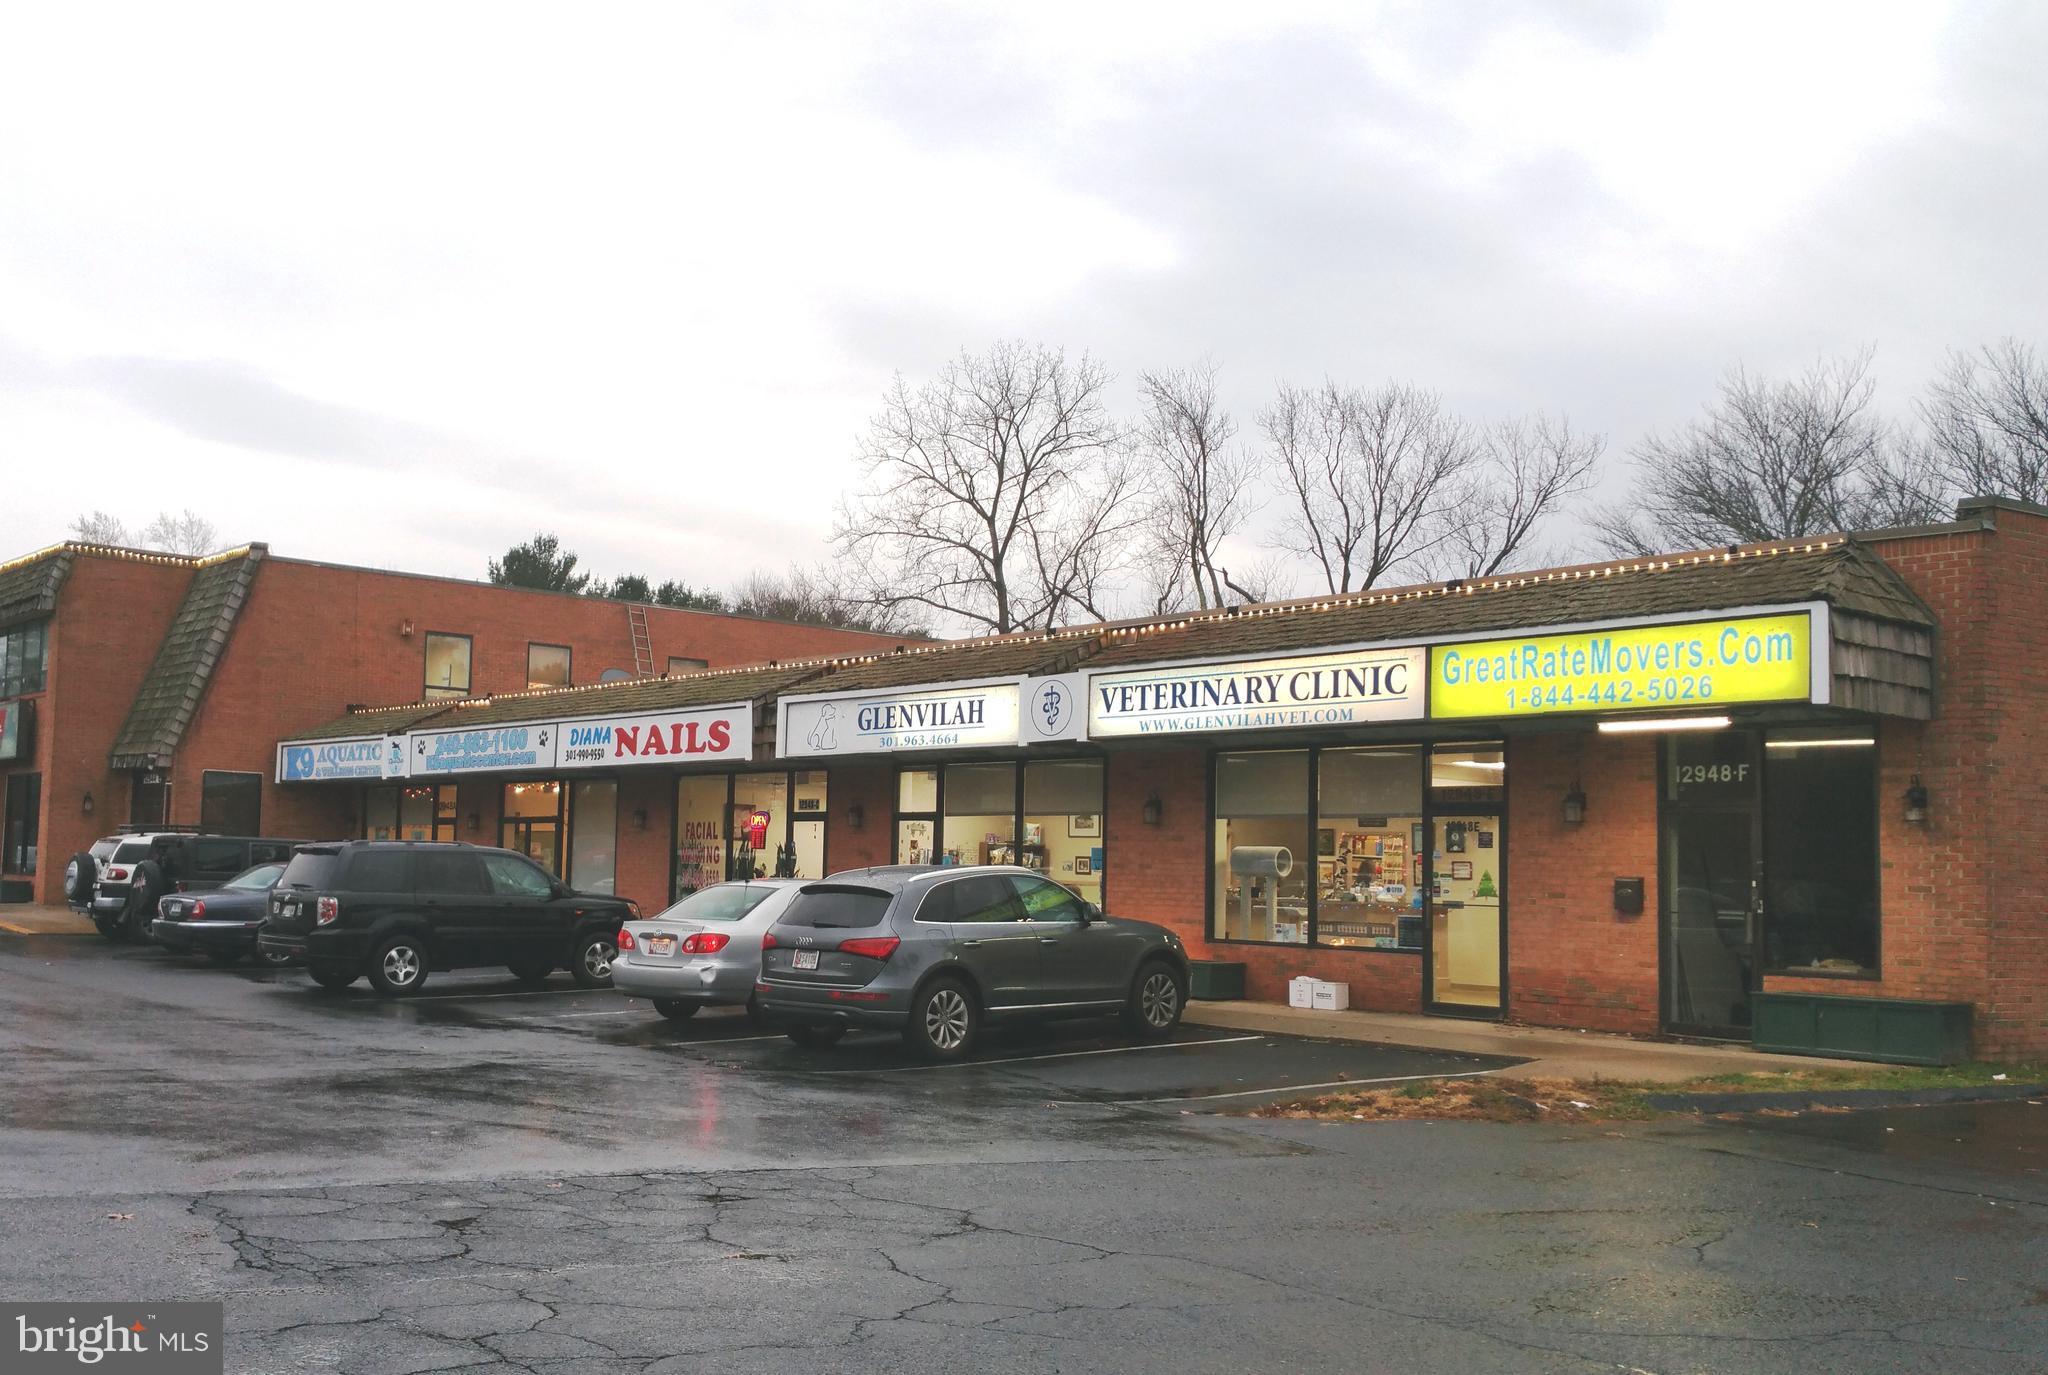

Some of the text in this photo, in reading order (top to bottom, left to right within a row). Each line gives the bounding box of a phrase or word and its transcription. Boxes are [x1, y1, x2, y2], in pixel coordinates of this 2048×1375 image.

[1443, 628, 1793, 685] GreatRateMovers.Com
[1100, 663, 1408, 713] VETERINARY CLINIC
[1506, 675, 1713, 709] 1-844-442-5026
[858, 699, 985, 731] GLENVILAH
[1139, 708, 1354, 732] WWW.GLENVILAHVET.COM
[570, 726, 612, 746] DIANA
[614, 720, 731, 757] NAILS
[879, 733, 959, 748] 301.963.4664
[286, 743, 383, 780] K9 AQUATIC
[565, 748, 605, 762] 301-990-9550
[685, 821, 719, 840] FACIAL
[751, 814, 767, 826] OPEN
